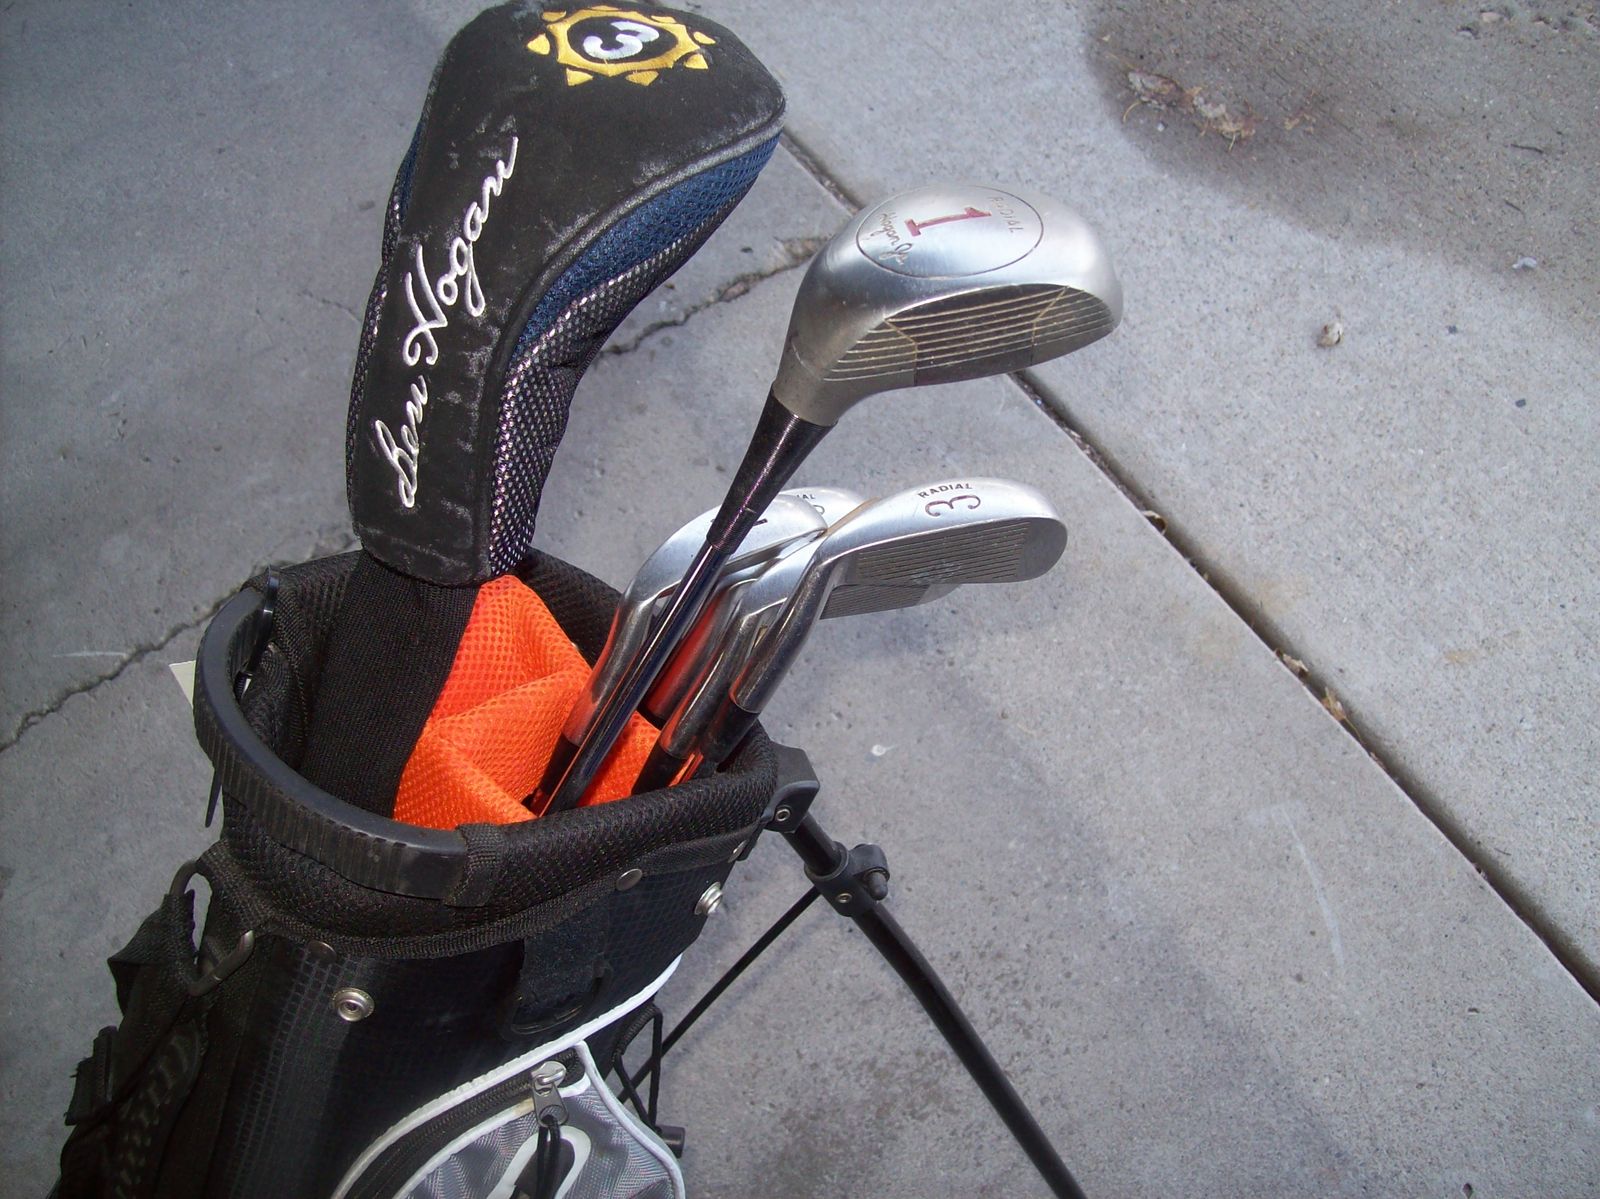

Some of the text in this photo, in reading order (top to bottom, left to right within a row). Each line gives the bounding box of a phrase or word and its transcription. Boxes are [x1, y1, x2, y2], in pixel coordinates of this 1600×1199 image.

[582, 20, 661, 61] 3
[904, 207, 992, 237] 1
[373, 136, 519, 508] Ben Hogan
[917, 483, 973, 498] RADIAL
[924, 494, 981, 517] 3
